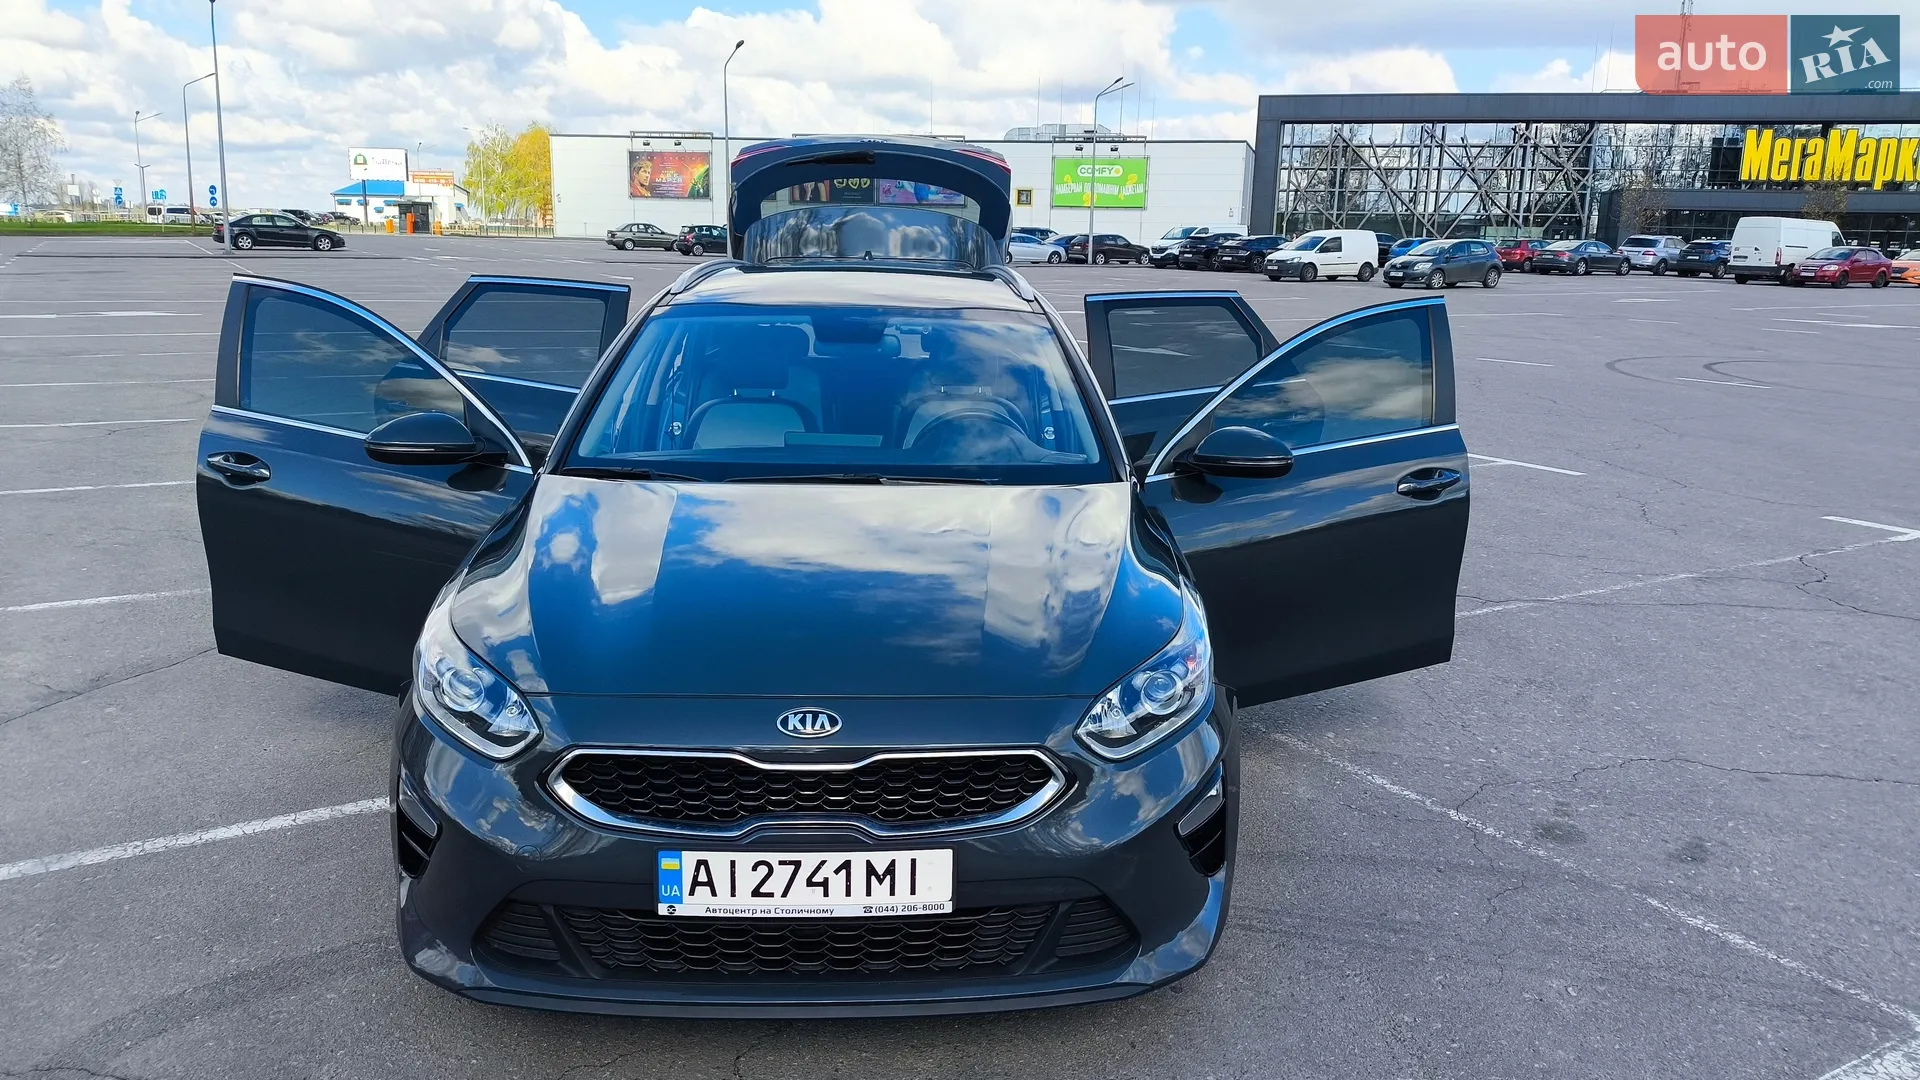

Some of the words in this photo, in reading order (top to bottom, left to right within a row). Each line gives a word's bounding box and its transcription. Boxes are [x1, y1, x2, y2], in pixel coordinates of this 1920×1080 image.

[1740, 128, 1920, 191] МегаМарк
[787, 713, 832, 731] KIA
[661, 884, 681, 897] UA
[704, 906, 758, 915] Автоцентр
[760, 907, 772, 915] на
[774, 907, 835, 916] Столичному
[874, 905, 899, 914] (044)
[901, 903, 945, 912] 206-8000
